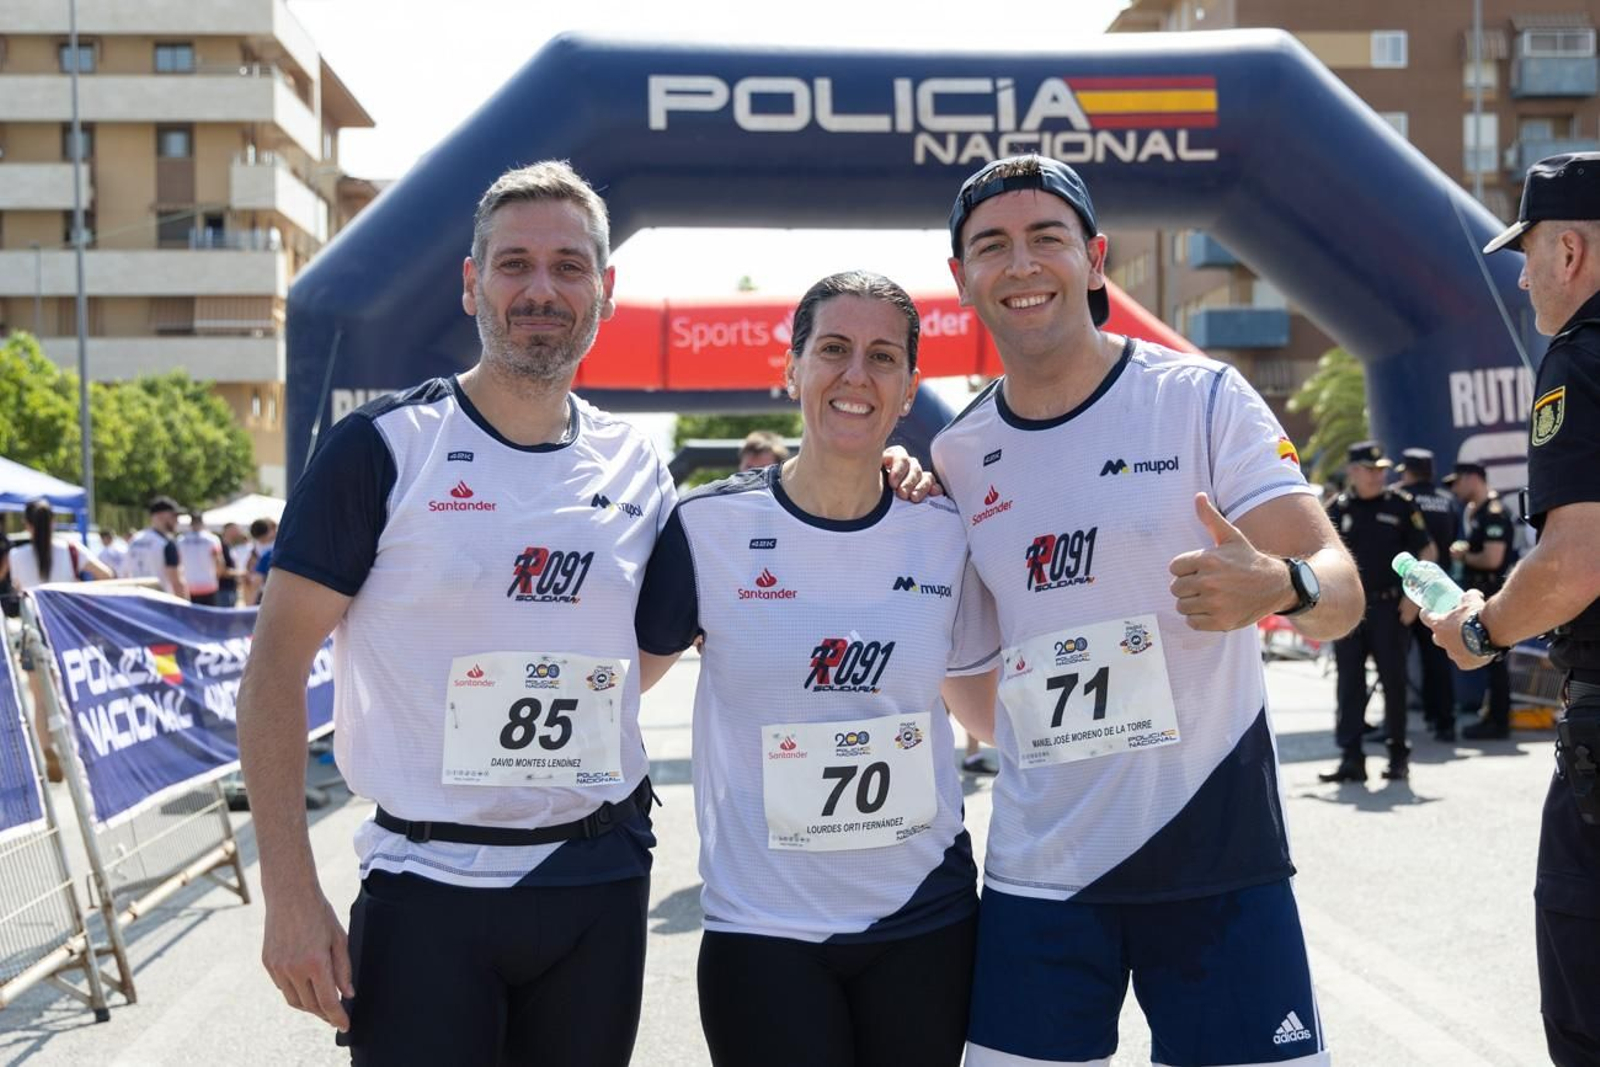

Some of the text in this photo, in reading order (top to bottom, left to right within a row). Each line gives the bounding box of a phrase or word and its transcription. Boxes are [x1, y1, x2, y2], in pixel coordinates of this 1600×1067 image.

[914, 129, 1218, 164] NACIONAL
[672, 316, 770, 353] Sports
[1133, 456, 1179, 475] mupol
[428, 501, 497, 512] Santander
[972, 500, 1013, 526] Santander
[737, 588, 797, 600] Santander
[454, 678, 495, 688] Santander
[1046, 666, 1110, 728] 71
[499, 697, 579, 751] 85
[1053, 733, 1070, 746] JOSÉ
[1071, 729, 1103, 742] MORENO
[1104, 727, 1115, 736] DE
[1116, 725, 1126, 734] LA
[1127, 719, 1152, 732] TORRE
[491, 757, 513, 767] DAVID
[515, 758, 546, 768] MONTES
[768, 751, 808, 760] Santander
[821, 761, 890, 817] 70
[806, 824, 842, 834] LOURDES
[862, 816, 904, 831] FERNÁNDEZ
[1273, 1029, 1311, 1044] adidas
